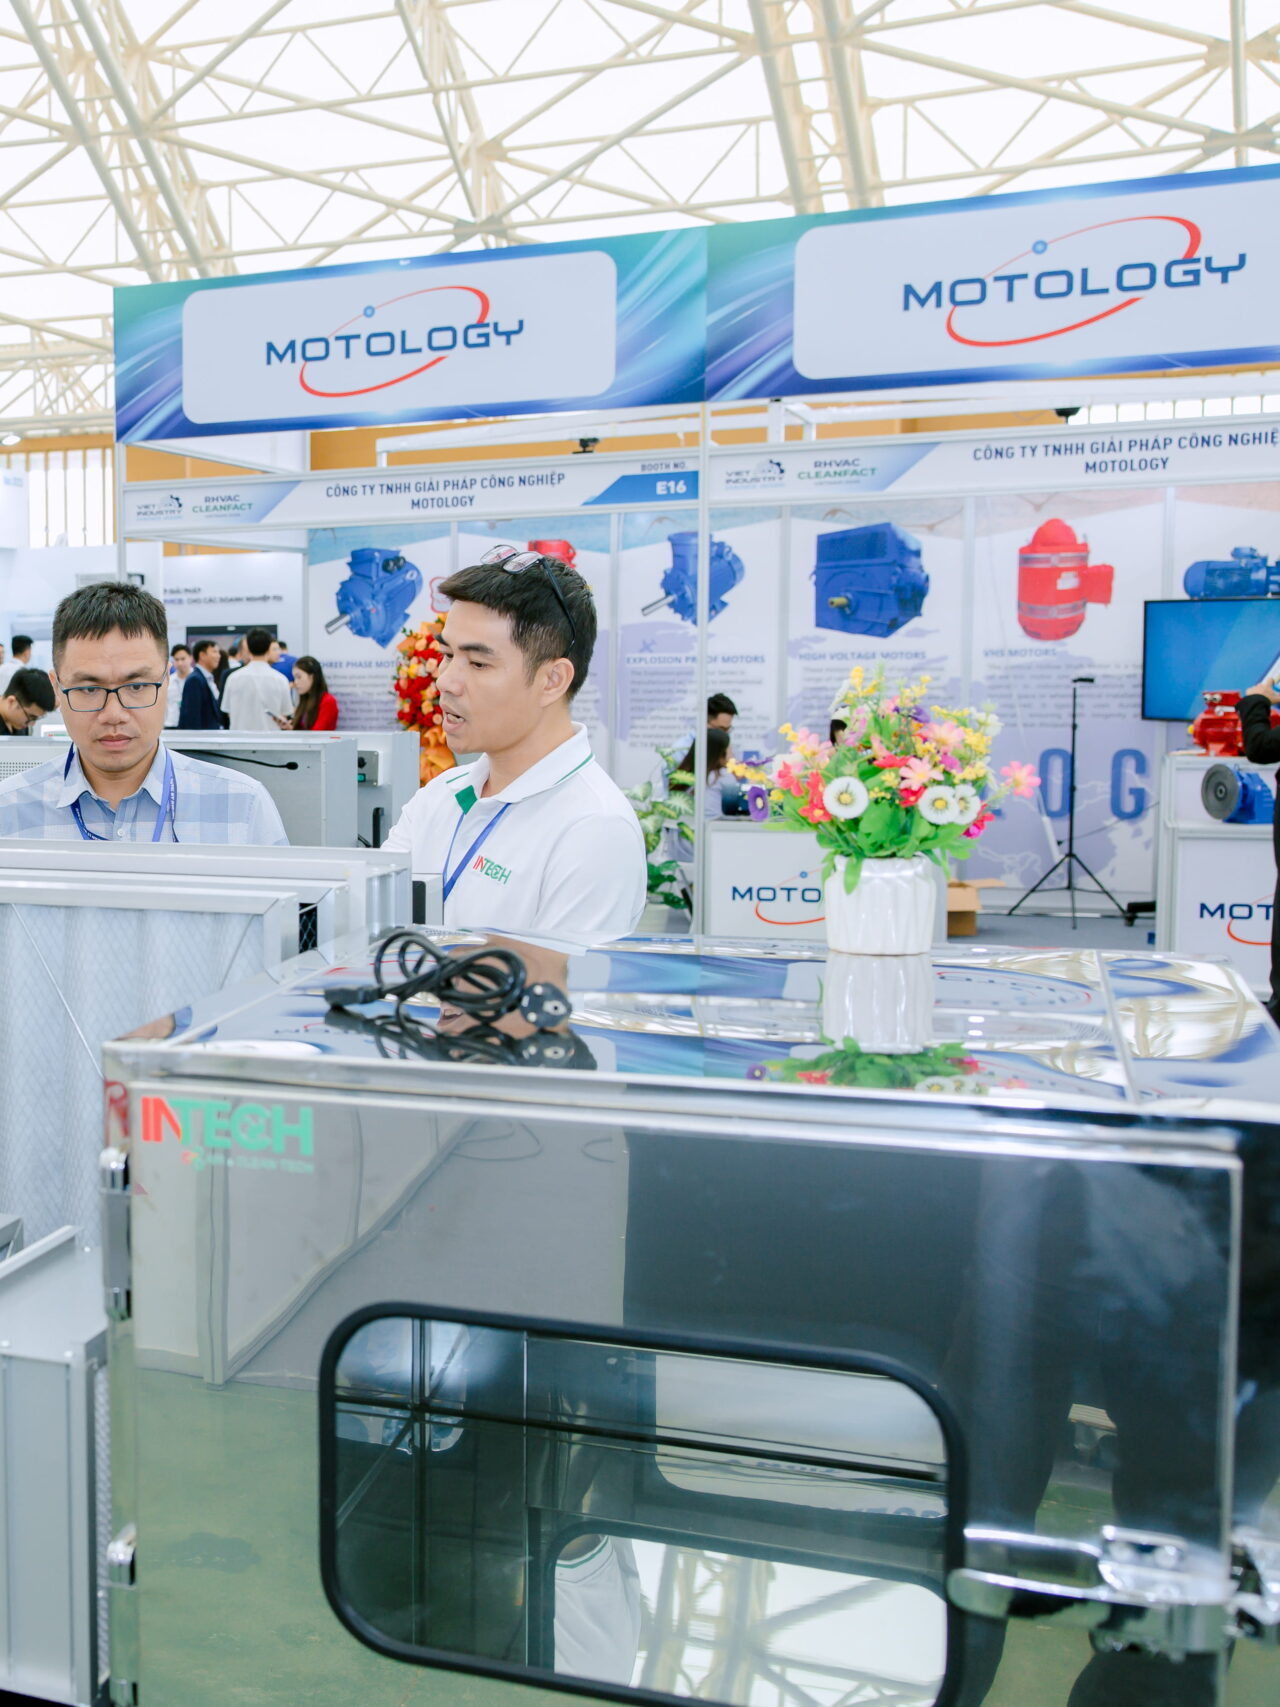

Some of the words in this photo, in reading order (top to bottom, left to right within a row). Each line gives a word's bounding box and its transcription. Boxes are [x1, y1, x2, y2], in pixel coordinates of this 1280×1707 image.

[902, 252, 1247, 312] MOTOLOGY
[266, 319, 524, 365] MOTOLOGY
[973, 444, 1015, 461] CÔNG
[1020, 446, 1038, 458] TY
[1043, 443, 1085, 457] TNHH
[1090, 436, 1123, 454] GIẢI
[1128, 435, 1173, 452] PHÁP
[1178, 431, 1223, 450] CÔNG
[1228, 427, 1279, 448] NGHIỆ
[640, 463, 671, 472] BOOTH
[814, 458, 861, 468] RHVAC
[1084, 457, 1170, 474] MOTOLOGY
[797, 468, 878, 480] CLEANFACT
[326, 483, 358, 498] CÔNG
[361, 485, 376, 496] TY
[379, 483, 412, 496] TNHH
[415, 479, 440, 494] GIẢI
[444, 477, 477, 492] PHÁP
[480, 475, 516, 490] CÔNG
[518, 471, 566, 488] NGHIỆP
[655, 480, 687, 495] E16
[204, 495, 240, 503] RHVAC
[411, 495, 475, 510] MOTOLOGY
[192, 503, 254, 513] CLEANFACT
[626, 655, 682, 664] EXPLOSION
[685, 655, 717, 664] PROF
[721, 655, 766, 664] MOTORS
[799, 652, 826, 661] HIGH
[829, 651, 877, 660] VOLTAGE
[880, 651, 927, 660] MOTORS
[1007, 648, 1057, 657] MOTORS
[473, 855, 512, 884] INTECH
[732, 886, 822, 903] MOTO
[1200, 903, 1274, 920] MOT
[141, 1095, 314, 1156] INTECH
